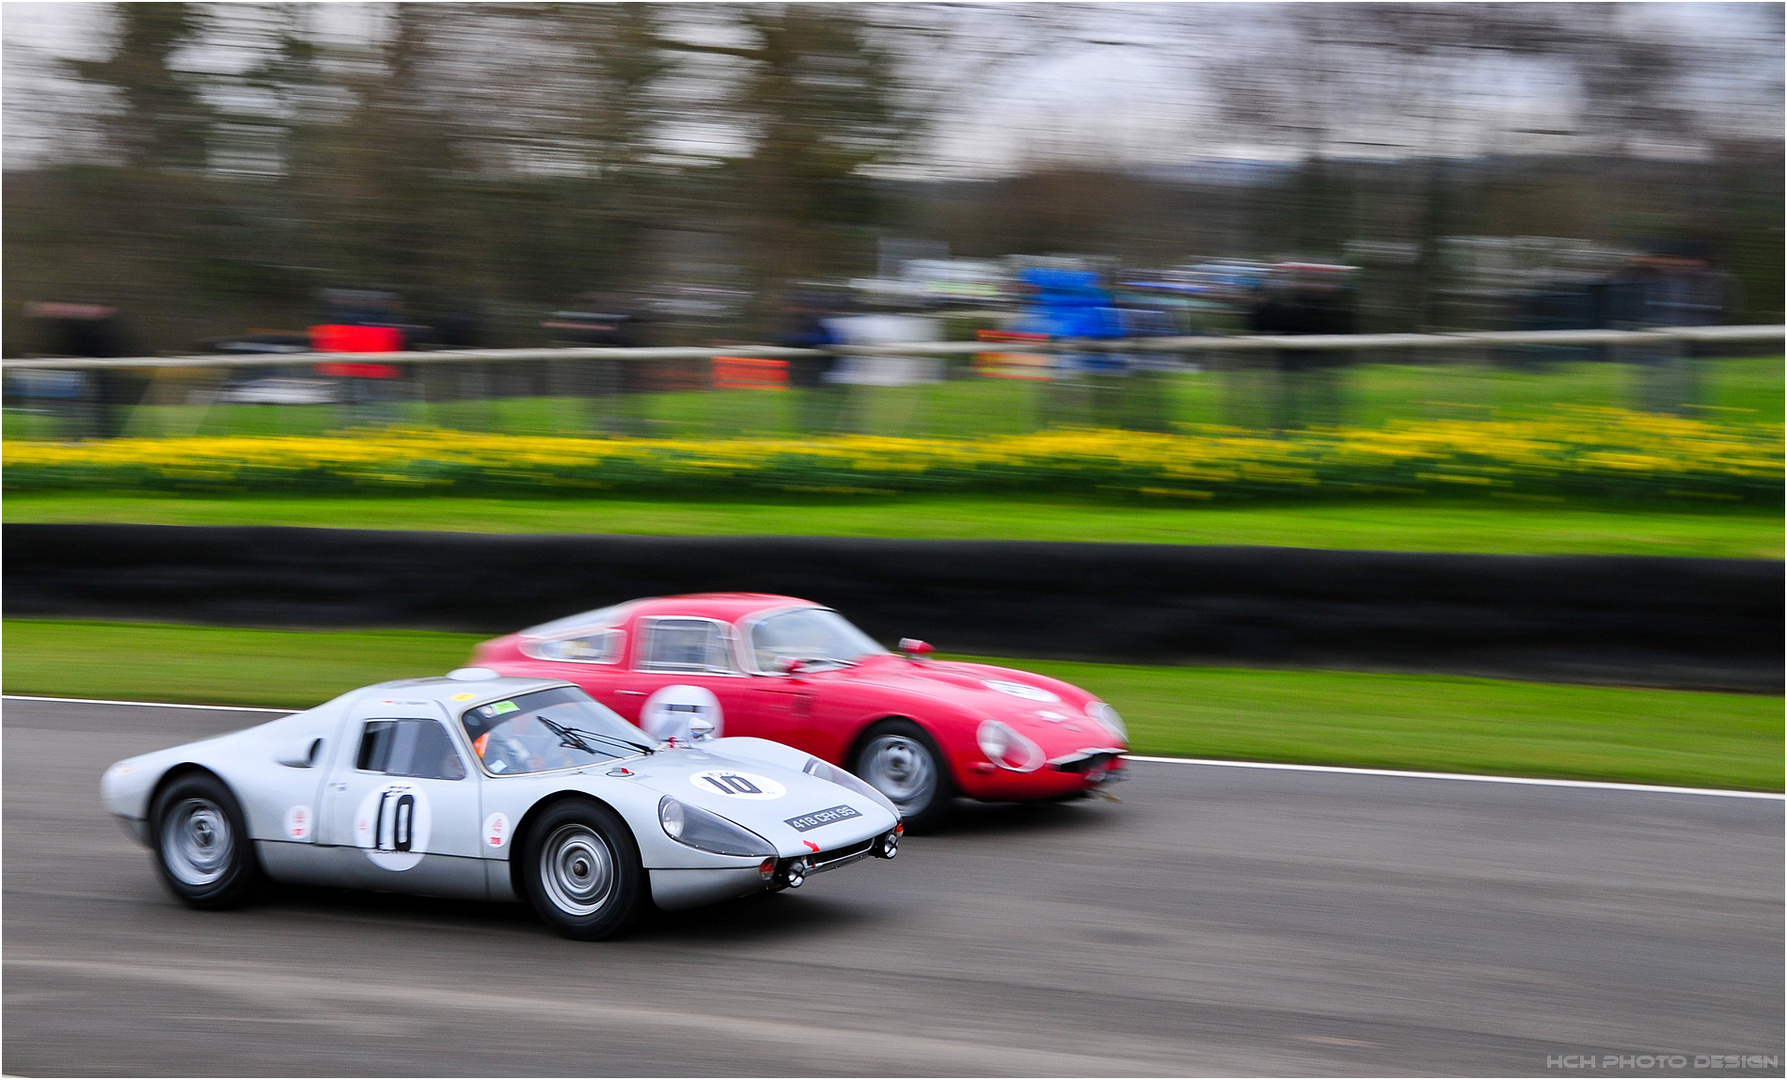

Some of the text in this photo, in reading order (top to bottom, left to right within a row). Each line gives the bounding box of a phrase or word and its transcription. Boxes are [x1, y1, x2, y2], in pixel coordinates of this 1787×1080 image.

[701, 776, 763, 794] 10
[375, 791, 415, 852] 10
[793, 817, 819, 828] 418
[836, 806, 856, 817] 95
